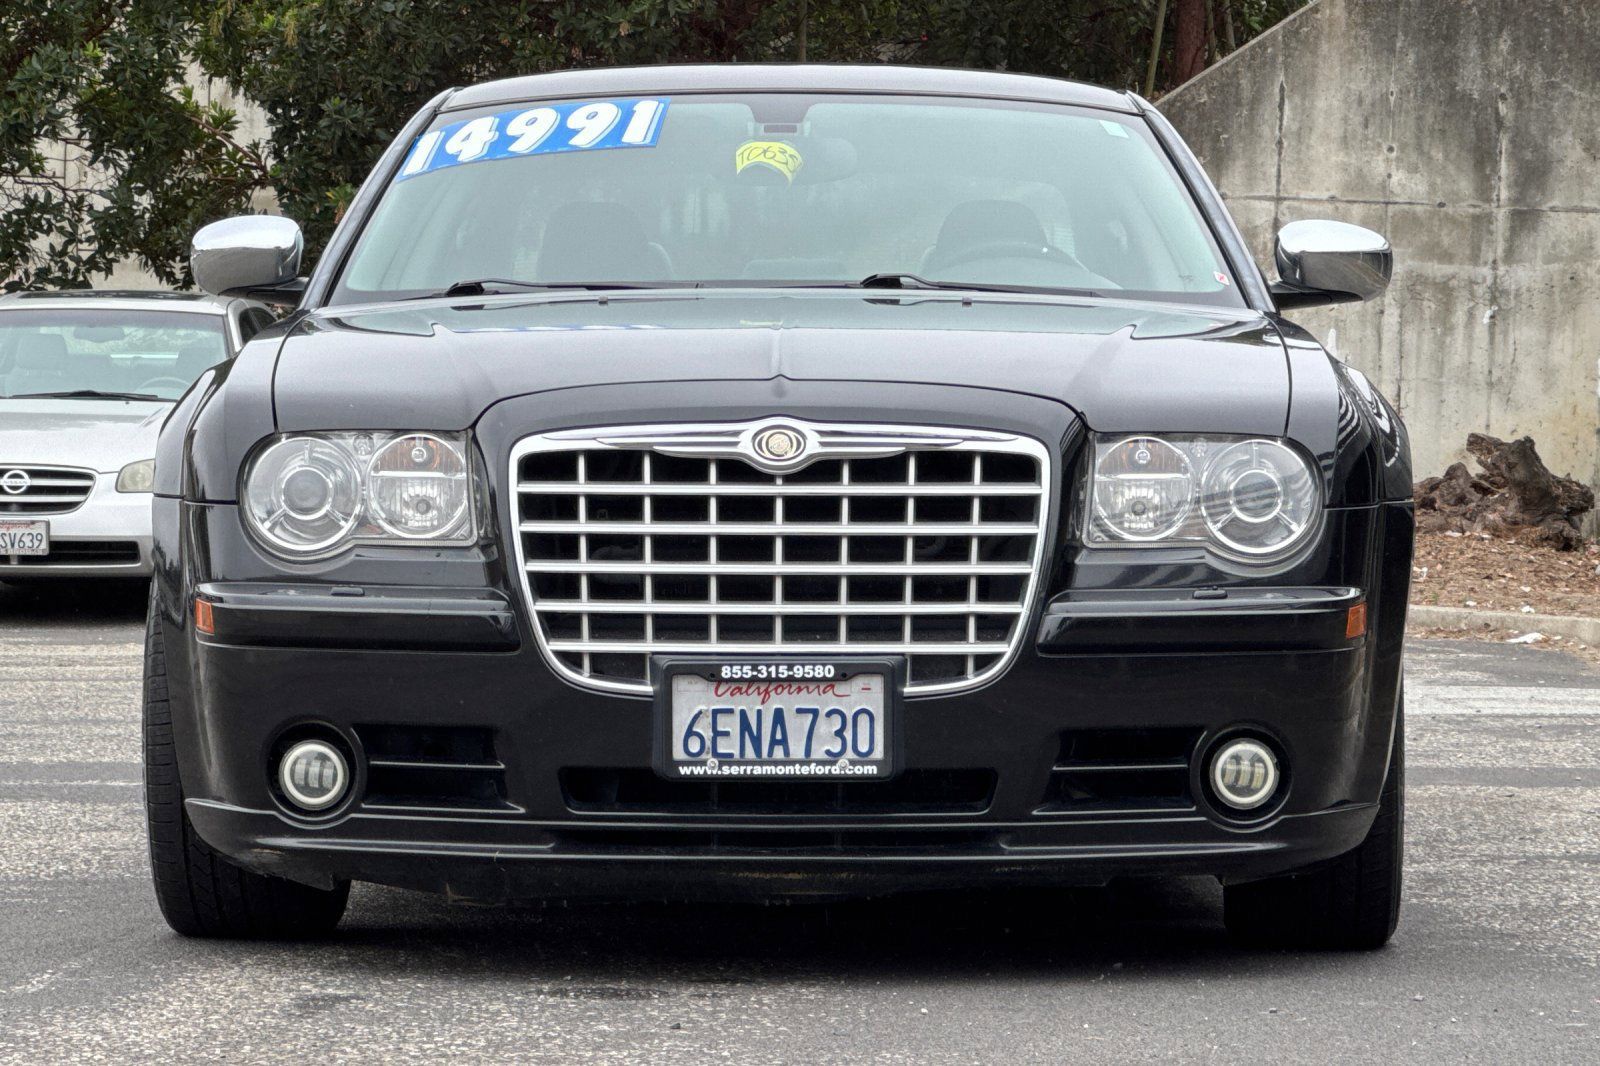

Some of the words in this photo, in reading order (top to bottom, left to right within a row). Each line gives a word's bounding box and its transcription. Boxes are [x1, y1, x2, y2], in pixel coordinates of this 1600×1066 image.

[402, 100, 664, 176] 14991
[0, 532, 44, 549] SV639
[721, 665, 835, 679] 855-315-9580
[714, 682, 851, 705] California
[682, 707, 875, 758] 6ENA730
[679, 763, 878, 775] www.serramonteford.com
